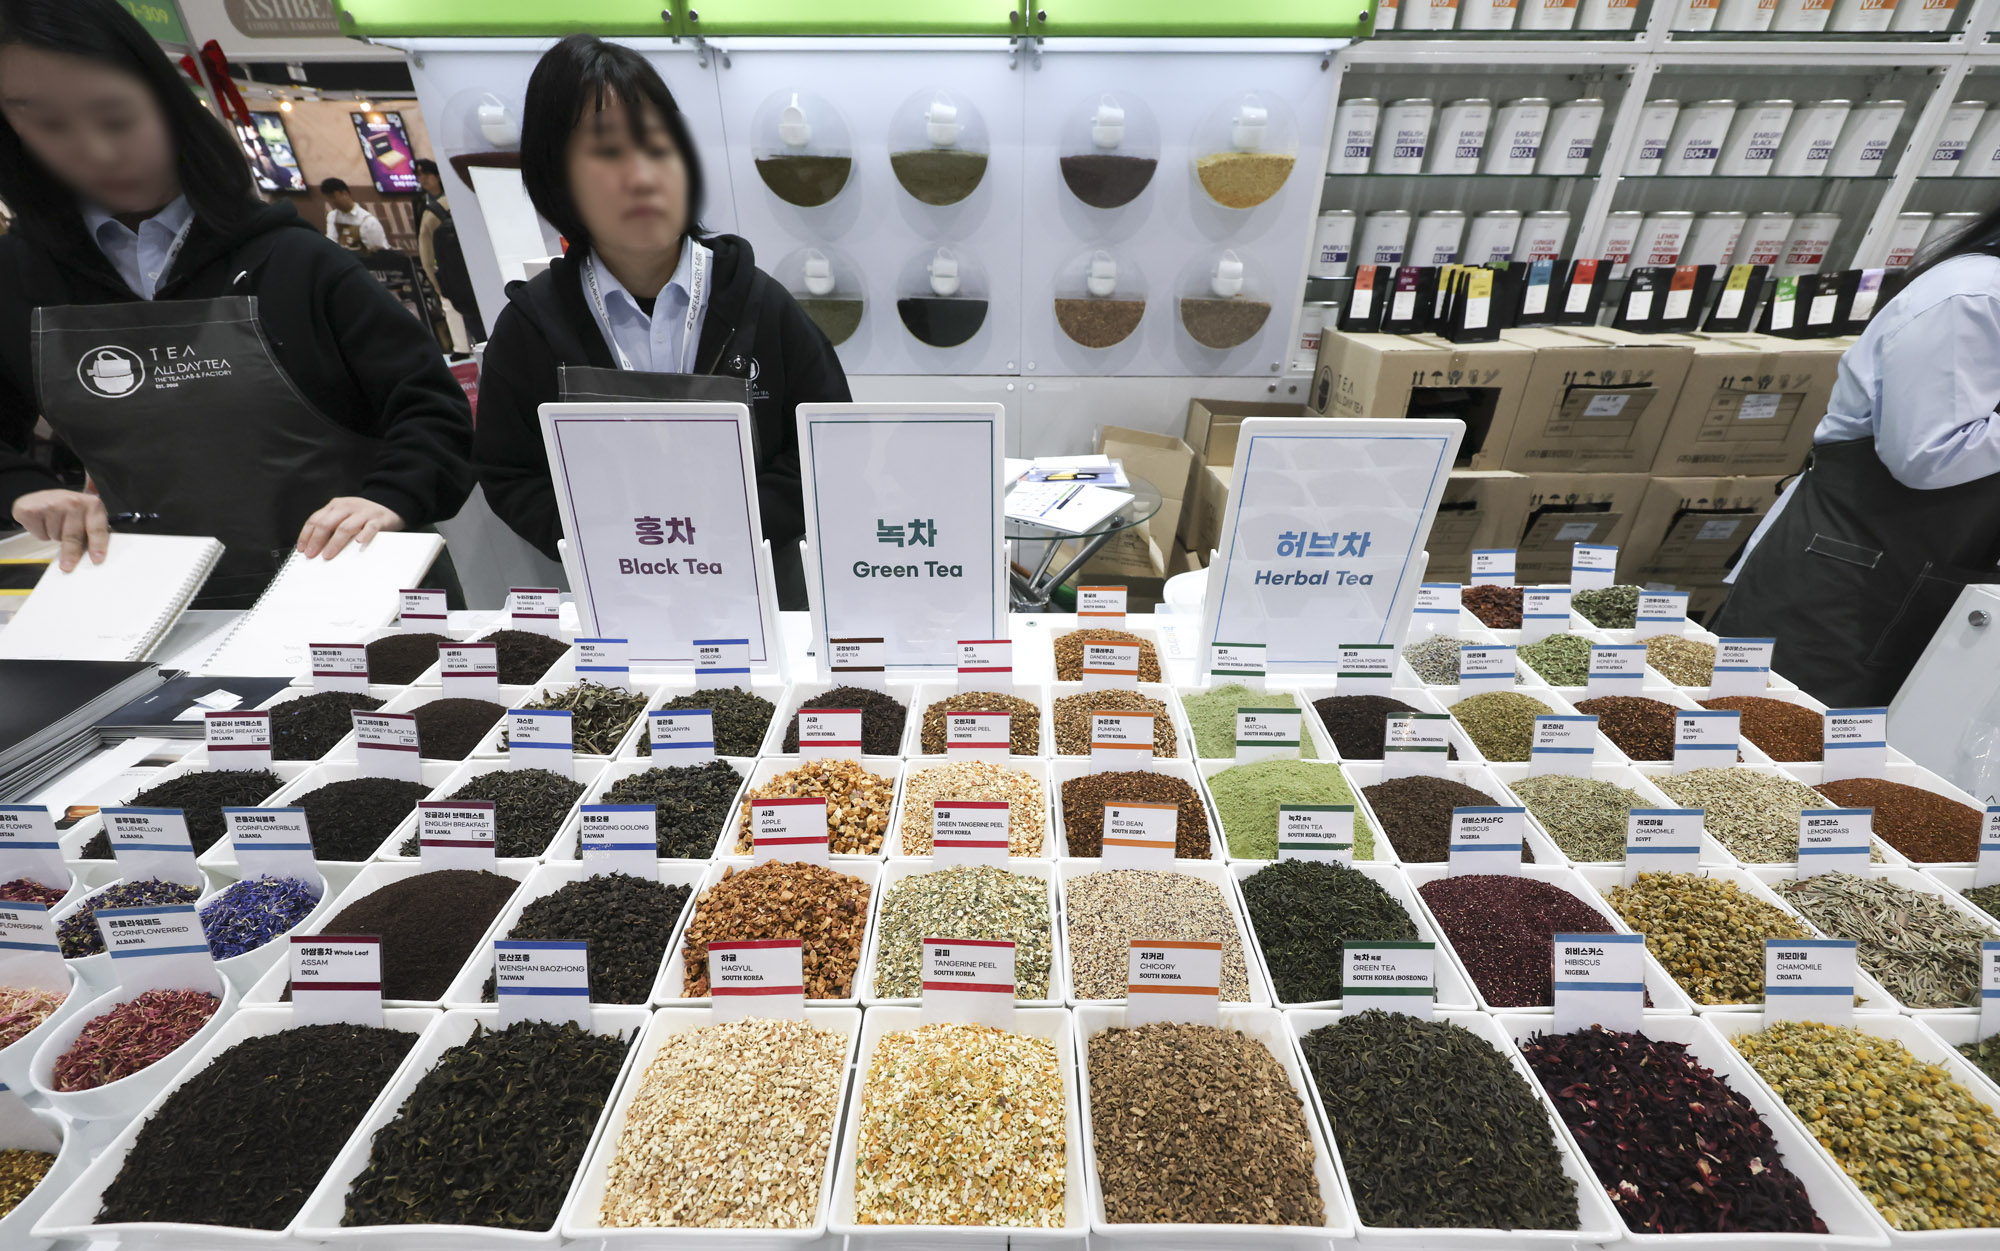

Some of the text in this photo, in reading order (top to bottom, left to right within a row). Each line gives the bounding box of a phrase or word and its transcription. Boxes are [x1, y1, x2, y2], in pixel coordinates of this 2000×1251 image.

[1346, 147, 1367, 157] B01-1
[1395, 147, 1418, 157] B01-1
[1456, 147, 1478, 157] B02-1
[1511, 148, 1534, 158] B02-1
[1568, 148, 1584, 158] B03
[1641, 148, 1657, 158] B03
[1684, 148, 1710, 159] B04-1
[1746, 149, 1772, 159] B02-1
[1934, 150, 1953, 160] B05
[1321, 253, 1336, 262] B15
[1375, 253, 1391, 262] B15
[154, 359, 231, 375] ALL DAY TEA
[634, 516, 696, 545] 홍차
[877, 519, 937, 547] 녹차
[1277, 531, 1371, 558] 허브차
[619, 558, 722, 574] Black Tea
[853, 561, 962, 578] Green Tea
[1255, 570, 1373, 585] Herbal Tea
[109, 918, 162, 929] 콘플라워레드
[111, 925, 189, 937] CORNFLOWERRED
[301, 947, 333, 956] 아쌈홍차
[934, 948, 950, 957] 귤피
[1140, 952, 1164, 961] 치커리
[1565, 947, 1604, 956] 히비스커스
[1777, 952, 1808, 960] 캐모마일
[498, 953, 530, 962] 문산포종
[720, 953, 737, 962] 하귤
[1353, 953, 1370, 961] 녹차
[934, 959, 977, 968] TANGERINE
[1139, 962, 1176, 970] CHICORY
[1564, 958, 1601, 967] HIBISCUS
